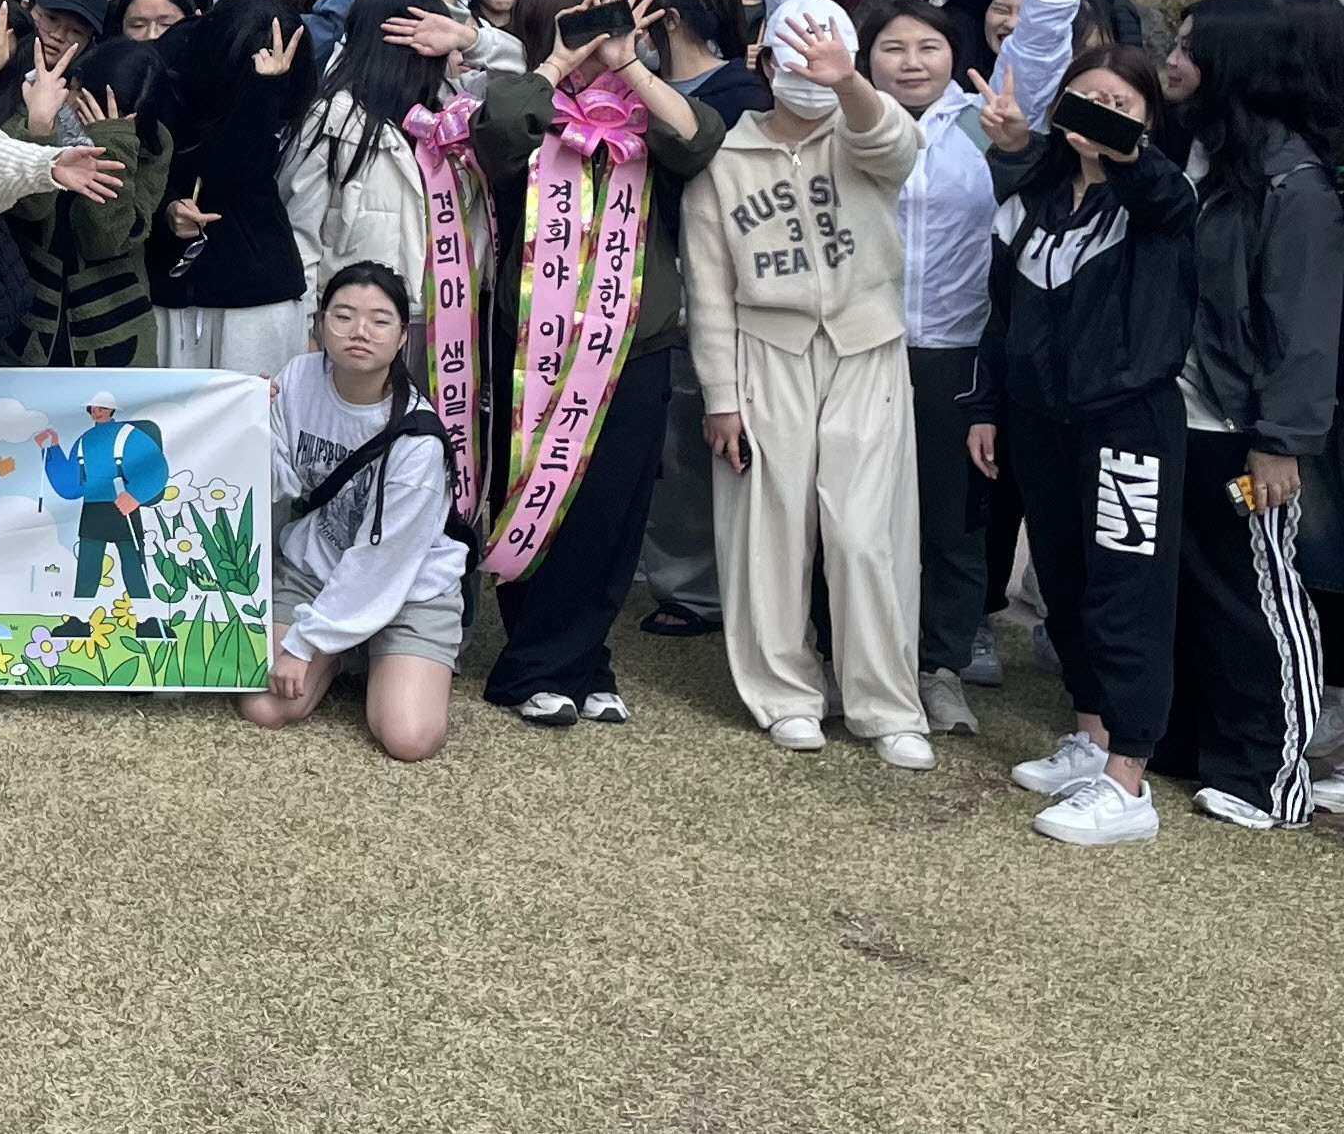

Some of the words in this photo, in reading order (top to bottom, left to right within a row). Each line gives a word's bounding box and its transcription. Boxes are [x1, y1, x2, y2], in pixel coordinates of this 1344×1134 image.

[431, 189, 465, 309] 경희야
[542, 180, 573, 291] 경희야
[587, 184, 636, 366] 사랑한다
[537, 314, 566, 386] 이런
[440, 340, 472, 523] 생일축하
[509, 391, 590, 558] 뉴트리아
[1094, 446, 1160, 556] NIKE
